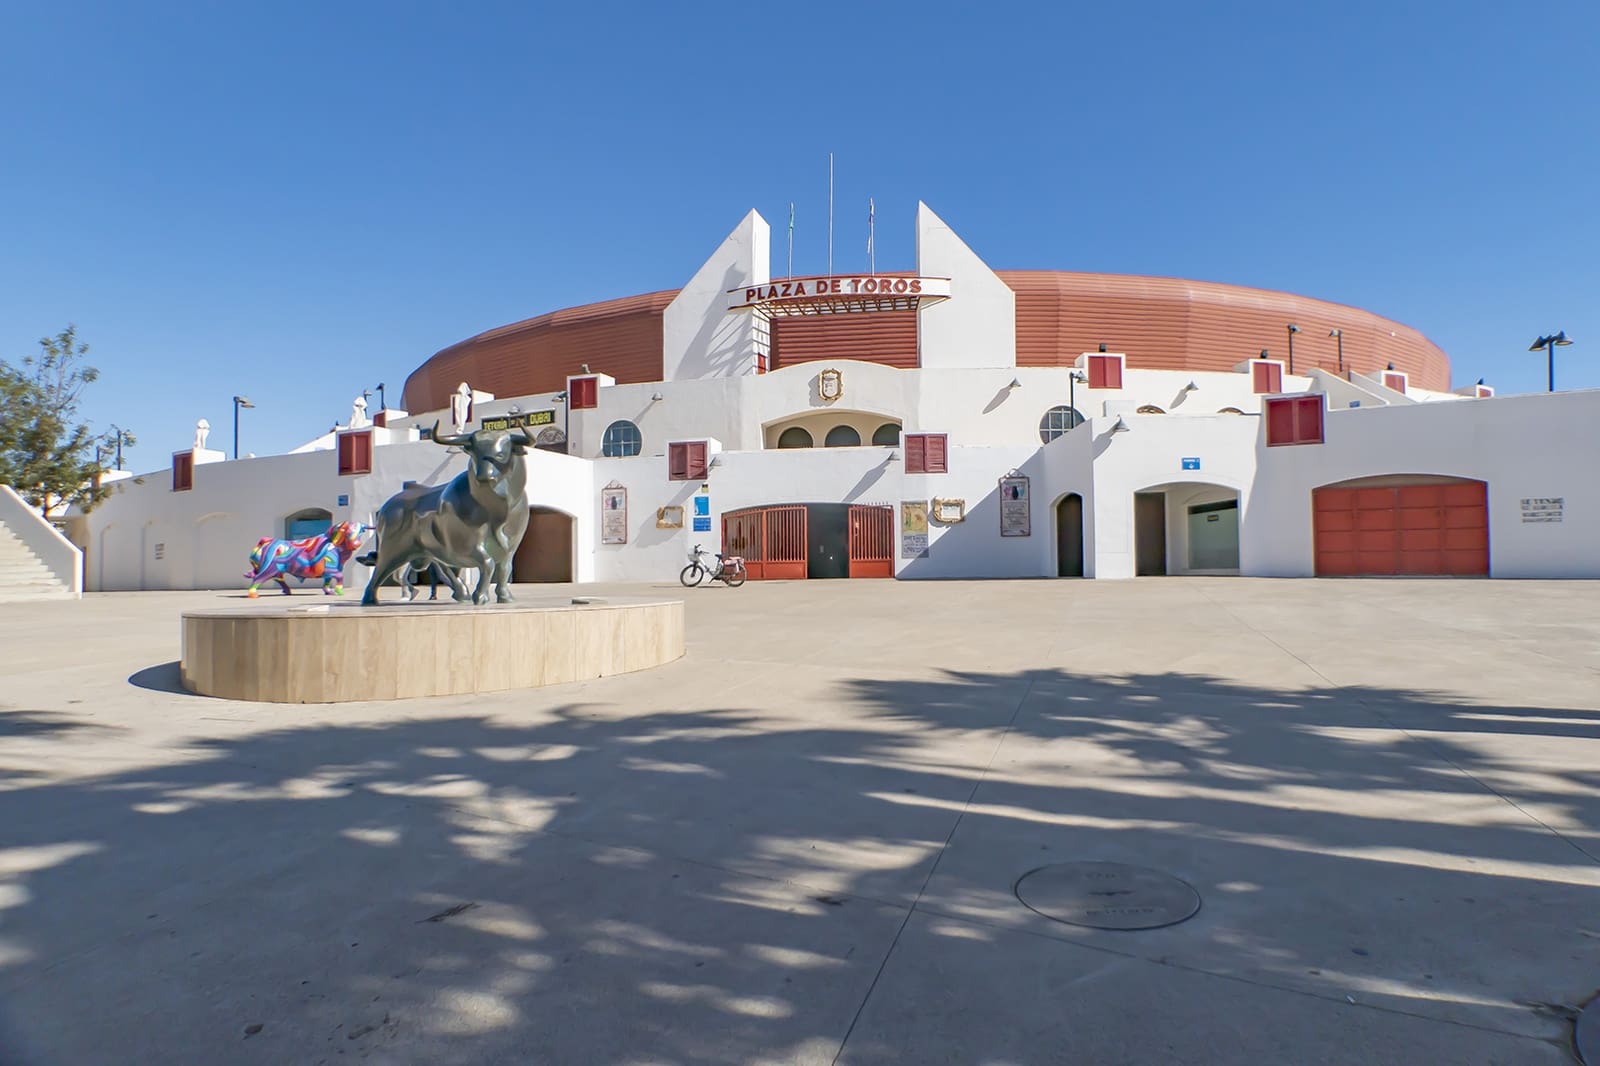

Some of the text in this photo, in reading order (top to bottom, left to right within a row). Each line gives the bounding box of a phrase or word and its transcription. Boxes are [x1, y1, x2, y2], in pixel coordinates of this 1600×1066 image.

[746, 278, 922, 302] PLAZA DE TOROS
